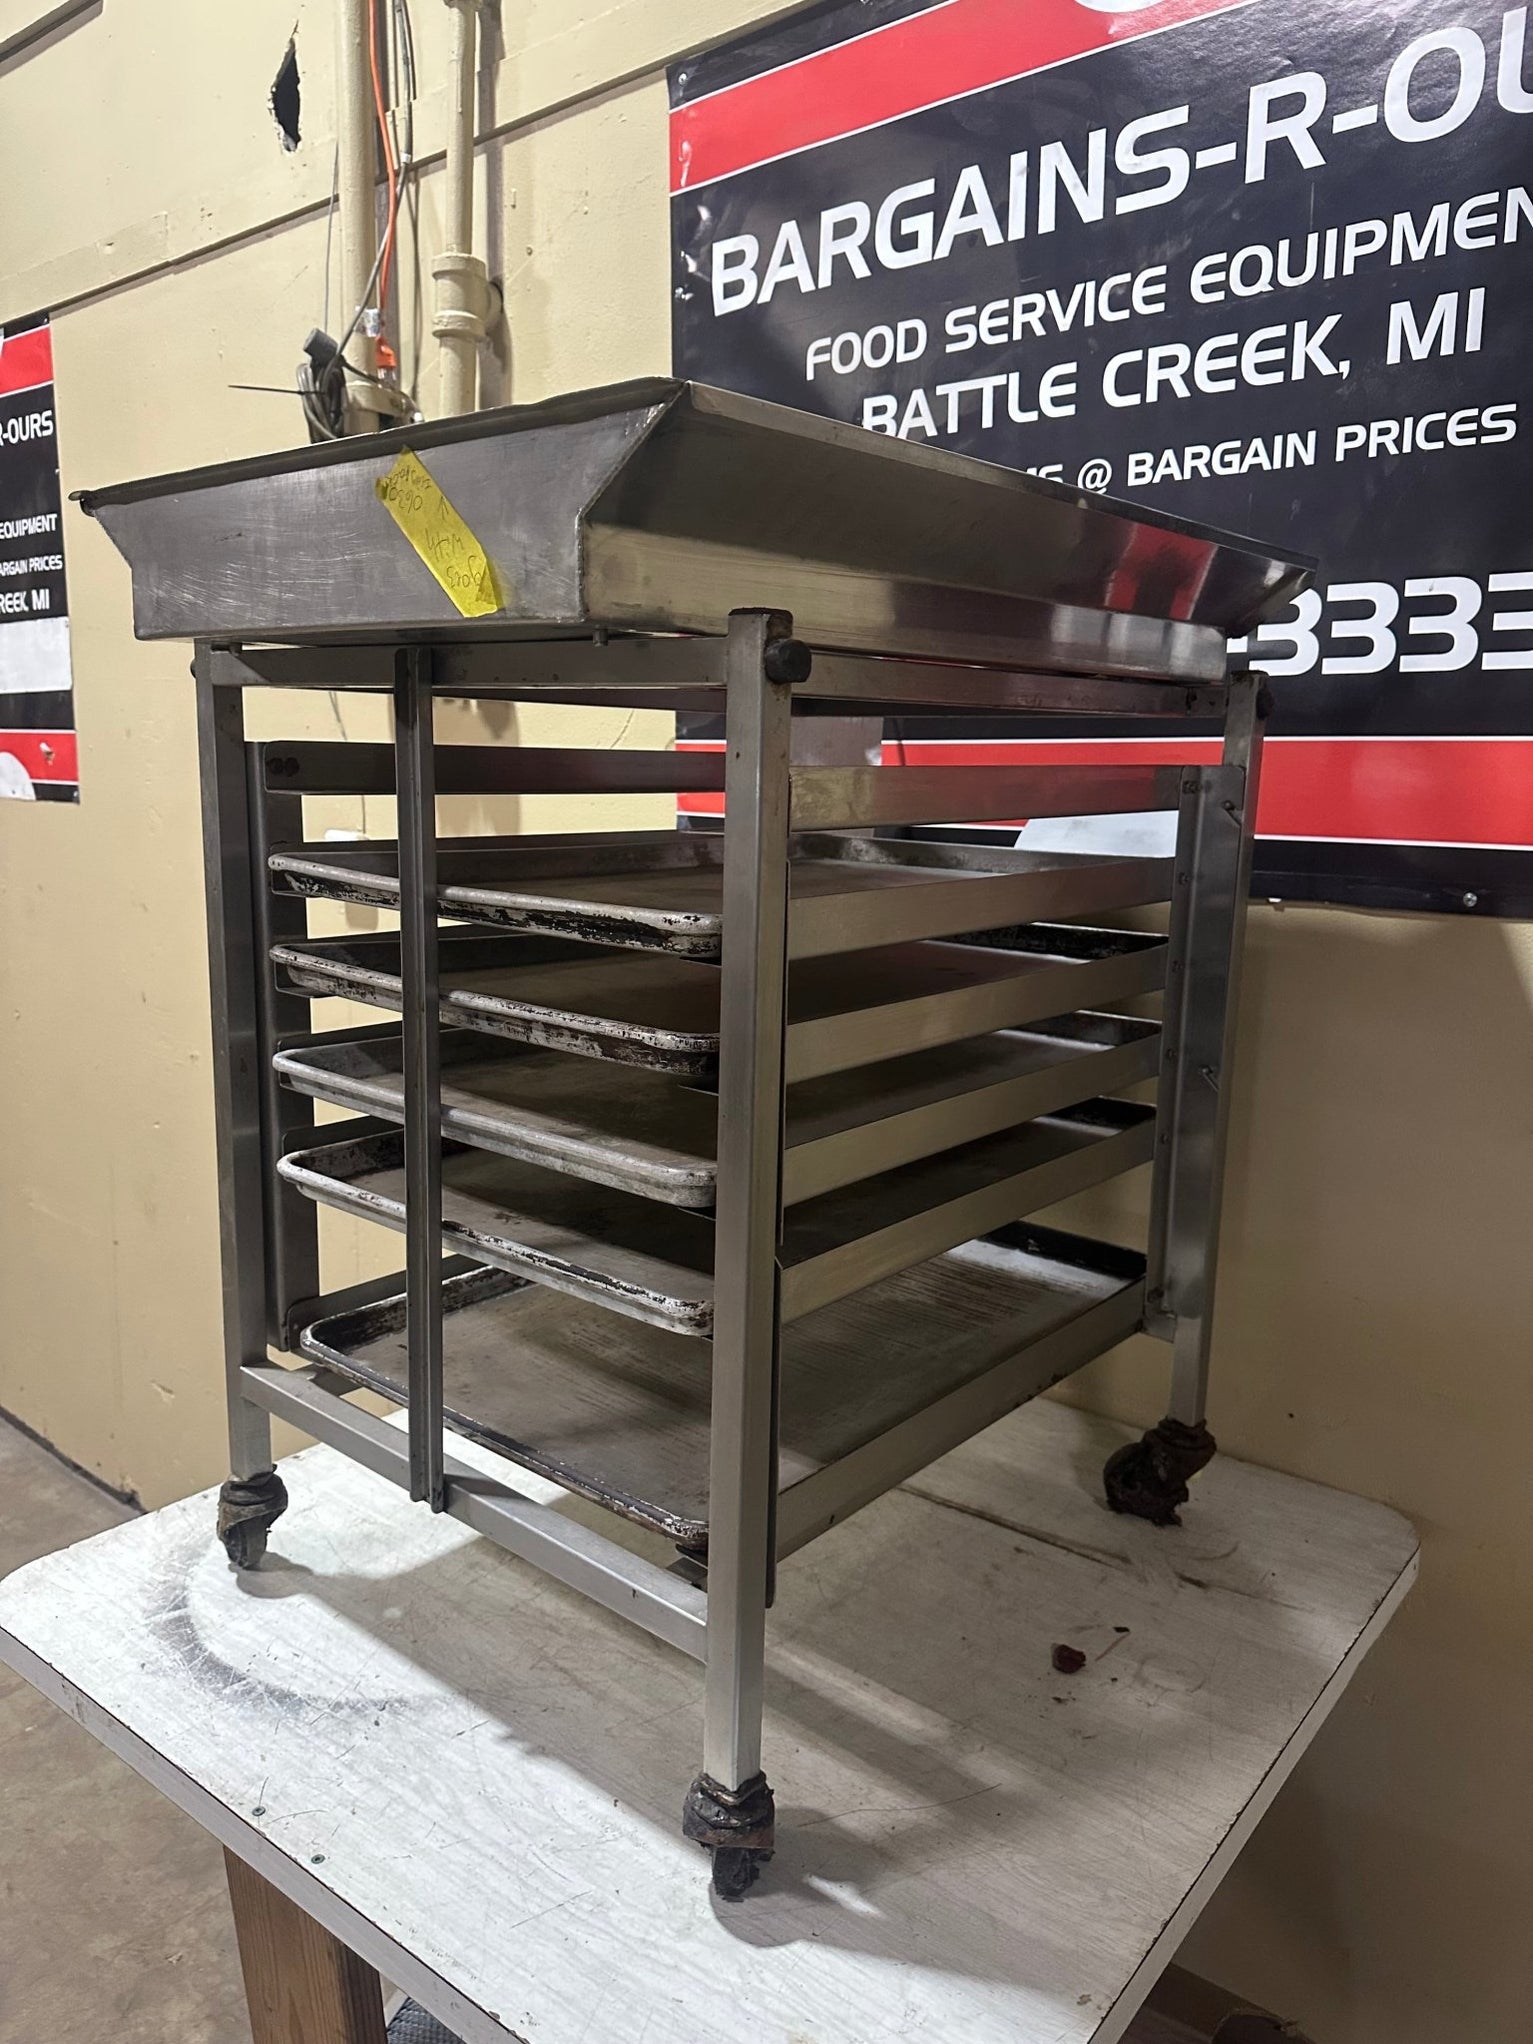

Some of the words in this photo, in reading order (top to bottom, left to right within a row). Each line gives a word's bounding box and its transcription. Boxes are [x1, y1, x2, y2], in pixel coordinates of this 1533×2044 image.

[806, 318, 928, 381] FOOD
[944, 265, 1167, 354] SERVICE
[862, 361, 1077, 440] BATTLE
[1102, 313, 1351, 408] CREEK,
[1386, 287, 1485, 365] MI
[0, 409, 54, 446] -OURS
[1127, 430, 1317, 487] BARGAIN
[1335, 403, 1517, 462] PRICES
[29, 554, 63, 572] PRICES
[31, 588, 50, 610] MI
